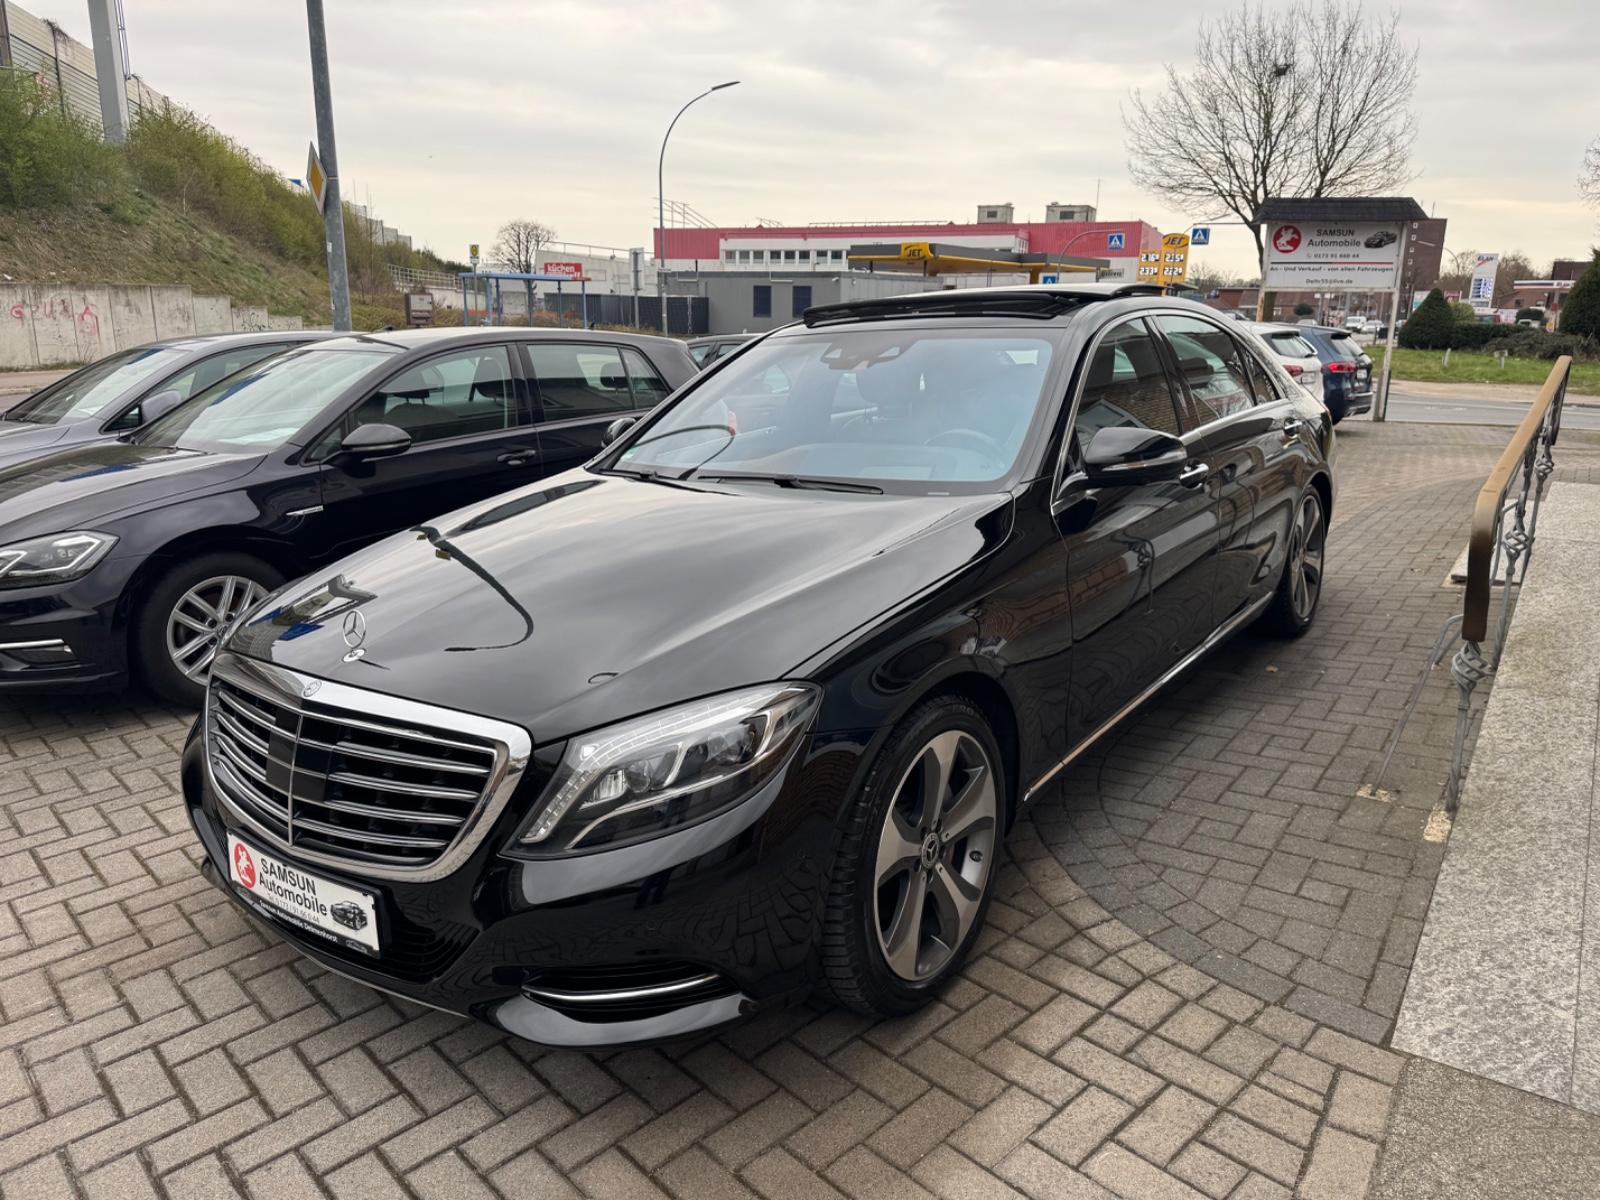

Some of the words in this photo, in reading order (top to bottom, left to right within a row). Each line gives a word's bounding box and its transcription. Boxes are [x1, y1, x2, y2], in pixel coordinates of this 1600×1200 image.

[1316, 228, 1355, 237] SAMSUN
[1164, 235, 1186, 246] JET
[1307, 239, 1361, 248] Automobile
[908, 249, 923, 257] JET
[547, 264, 575, 273] küchen
[260, 857, 317, 896] SAMSUN
[259, 873, 328, 916] Automobile
